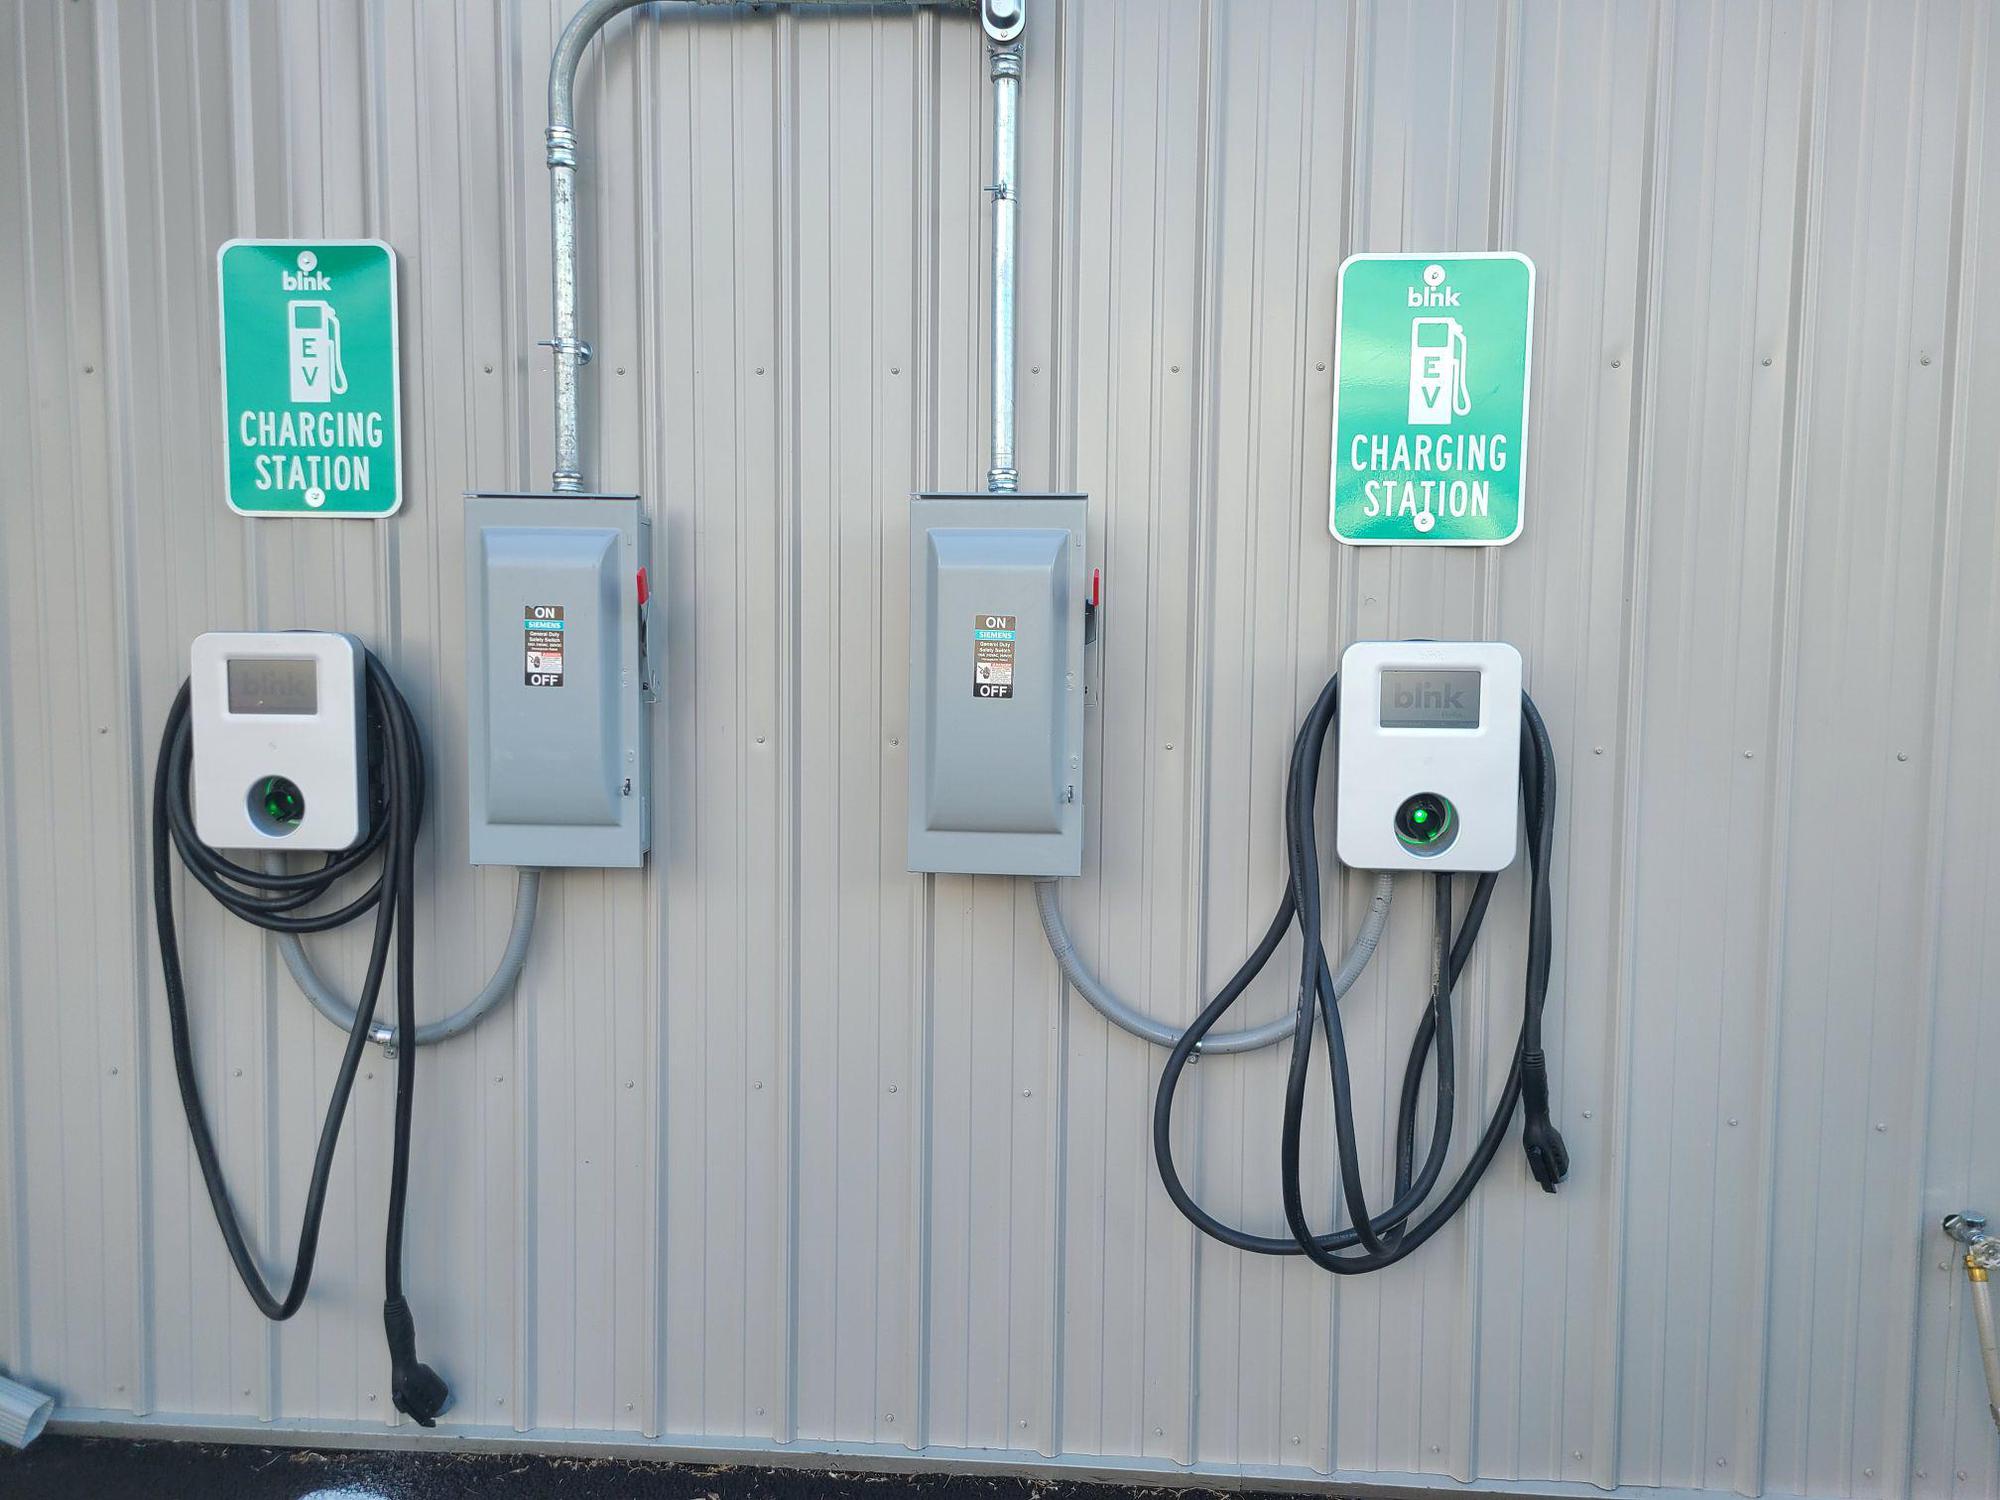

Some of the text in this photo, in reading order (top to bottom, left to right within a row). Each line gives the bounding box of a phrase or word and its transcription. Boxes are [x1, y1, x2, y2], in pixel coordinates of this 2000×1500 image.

[282, 270, 332, 291] blink
[1408, 286, 1462, 307] blink
[240, 410, 383, 448] CHARGING
[1351, 433, 1507, 472] CHARGING
[255, 455, 370, 491] STATION
[1363, 480, 1489, 517] STATION
[534, 606, 555, 619] ON
[985, 616, 1006, 629] ON
[528, 621, 562, 629] SIEMENS
[979, 631, 1012, 639] SIEMENS
[242, 671, 306, 696] blink
[531, 674, 558, 686] OFF
[980, 685, 1008, 697] OFF
[1394, 681, 1465, 709] blink
